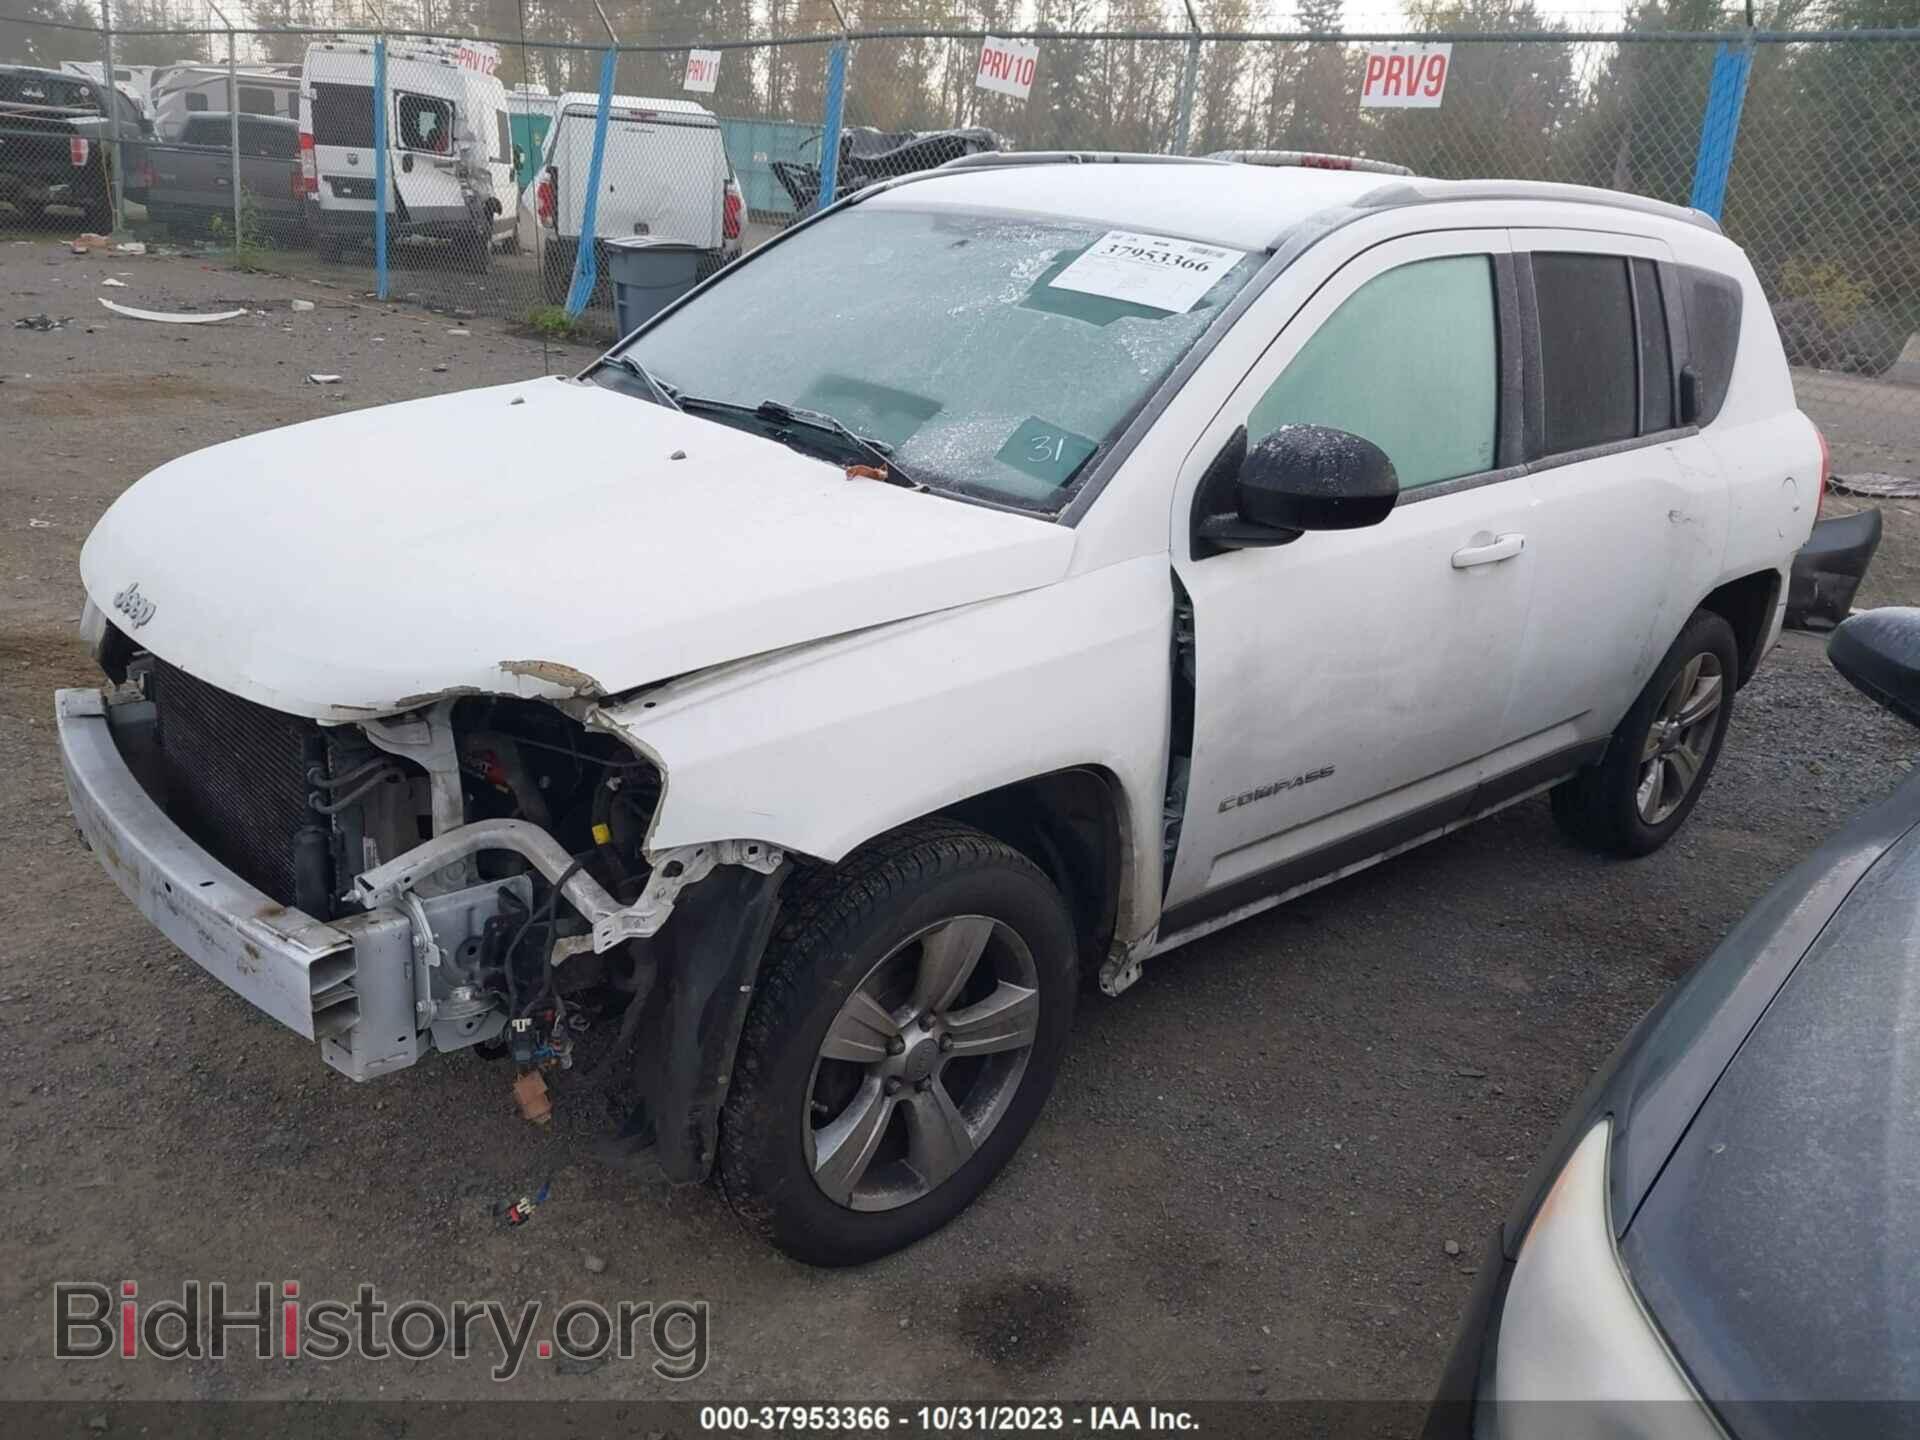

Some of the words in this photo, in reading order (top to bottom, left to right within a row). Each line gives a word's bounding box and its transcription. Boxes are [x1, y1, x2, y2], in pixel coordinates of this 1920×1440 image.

[1363, 53, 1447, 97] PRV9
[1101, 244, 1212, 273] 37953366
[1027, 435, 1065, 463] 31
[1218, 764, 1336, 814] COMPASS
